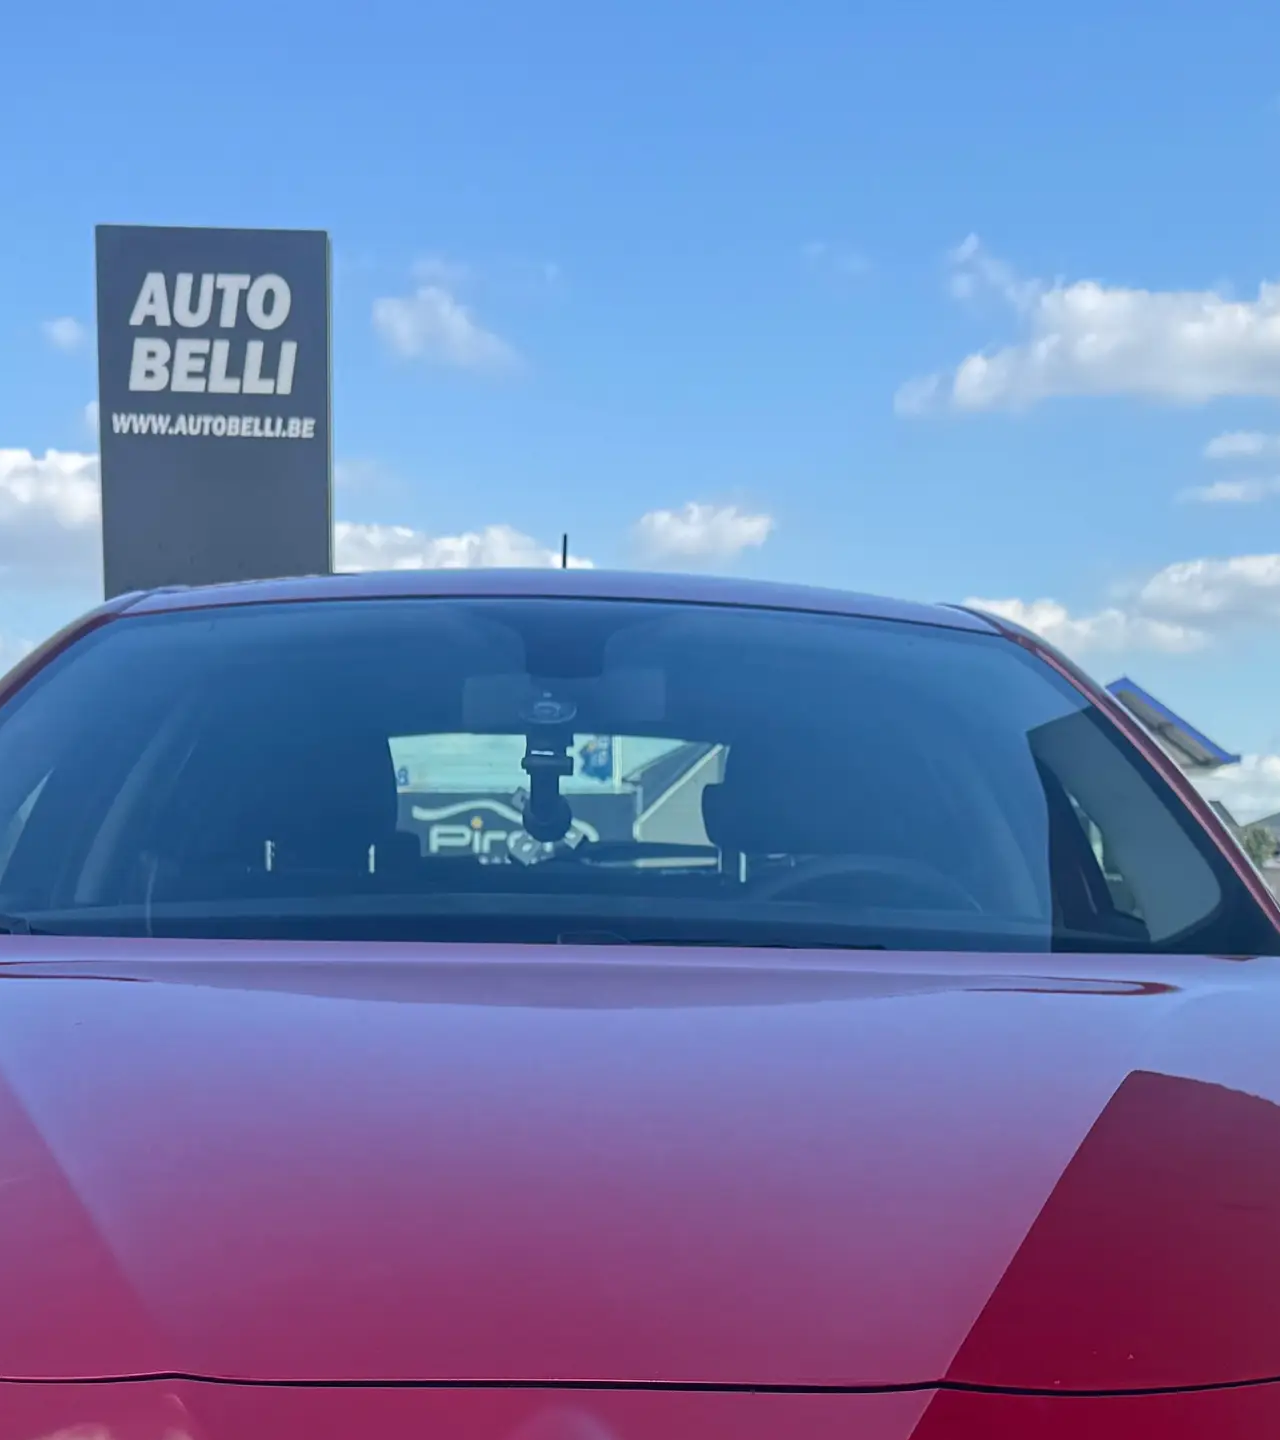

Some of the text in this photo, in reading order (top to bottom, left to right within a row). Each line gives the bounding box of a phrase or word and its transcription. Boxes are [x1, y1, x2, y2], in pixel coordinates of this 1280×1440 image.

[128, 271, 292, 330] AUTO
[128, 336, 298, 395] BELLI
[111, 411, 317, 439] WWW.AUTOBELLI.BE
